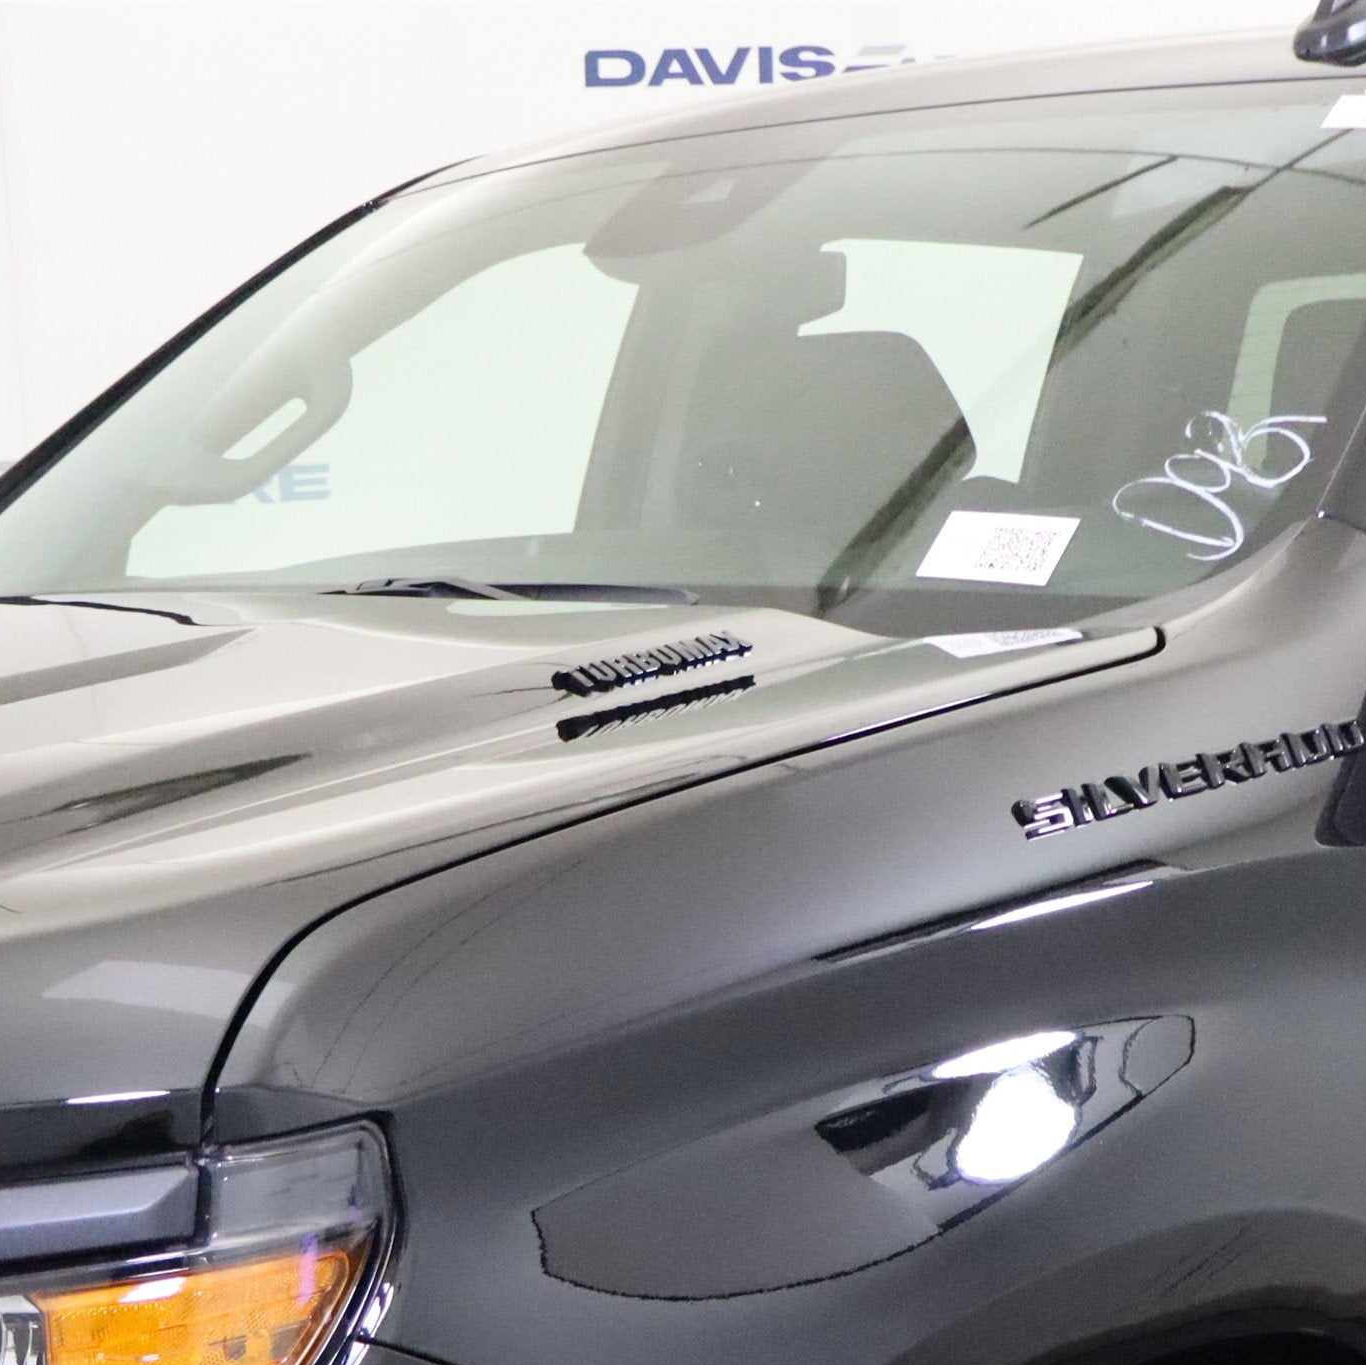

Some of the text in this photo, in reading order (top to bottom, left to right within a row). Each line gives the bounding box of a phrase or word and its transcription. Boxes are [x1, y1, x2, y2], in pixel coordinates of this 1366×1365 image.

[584, 45, 835, 87] DAVIS
[552, 629, 753, 697] TURBOMAX
[1011, 719, 1365, 840] SILVERADO
